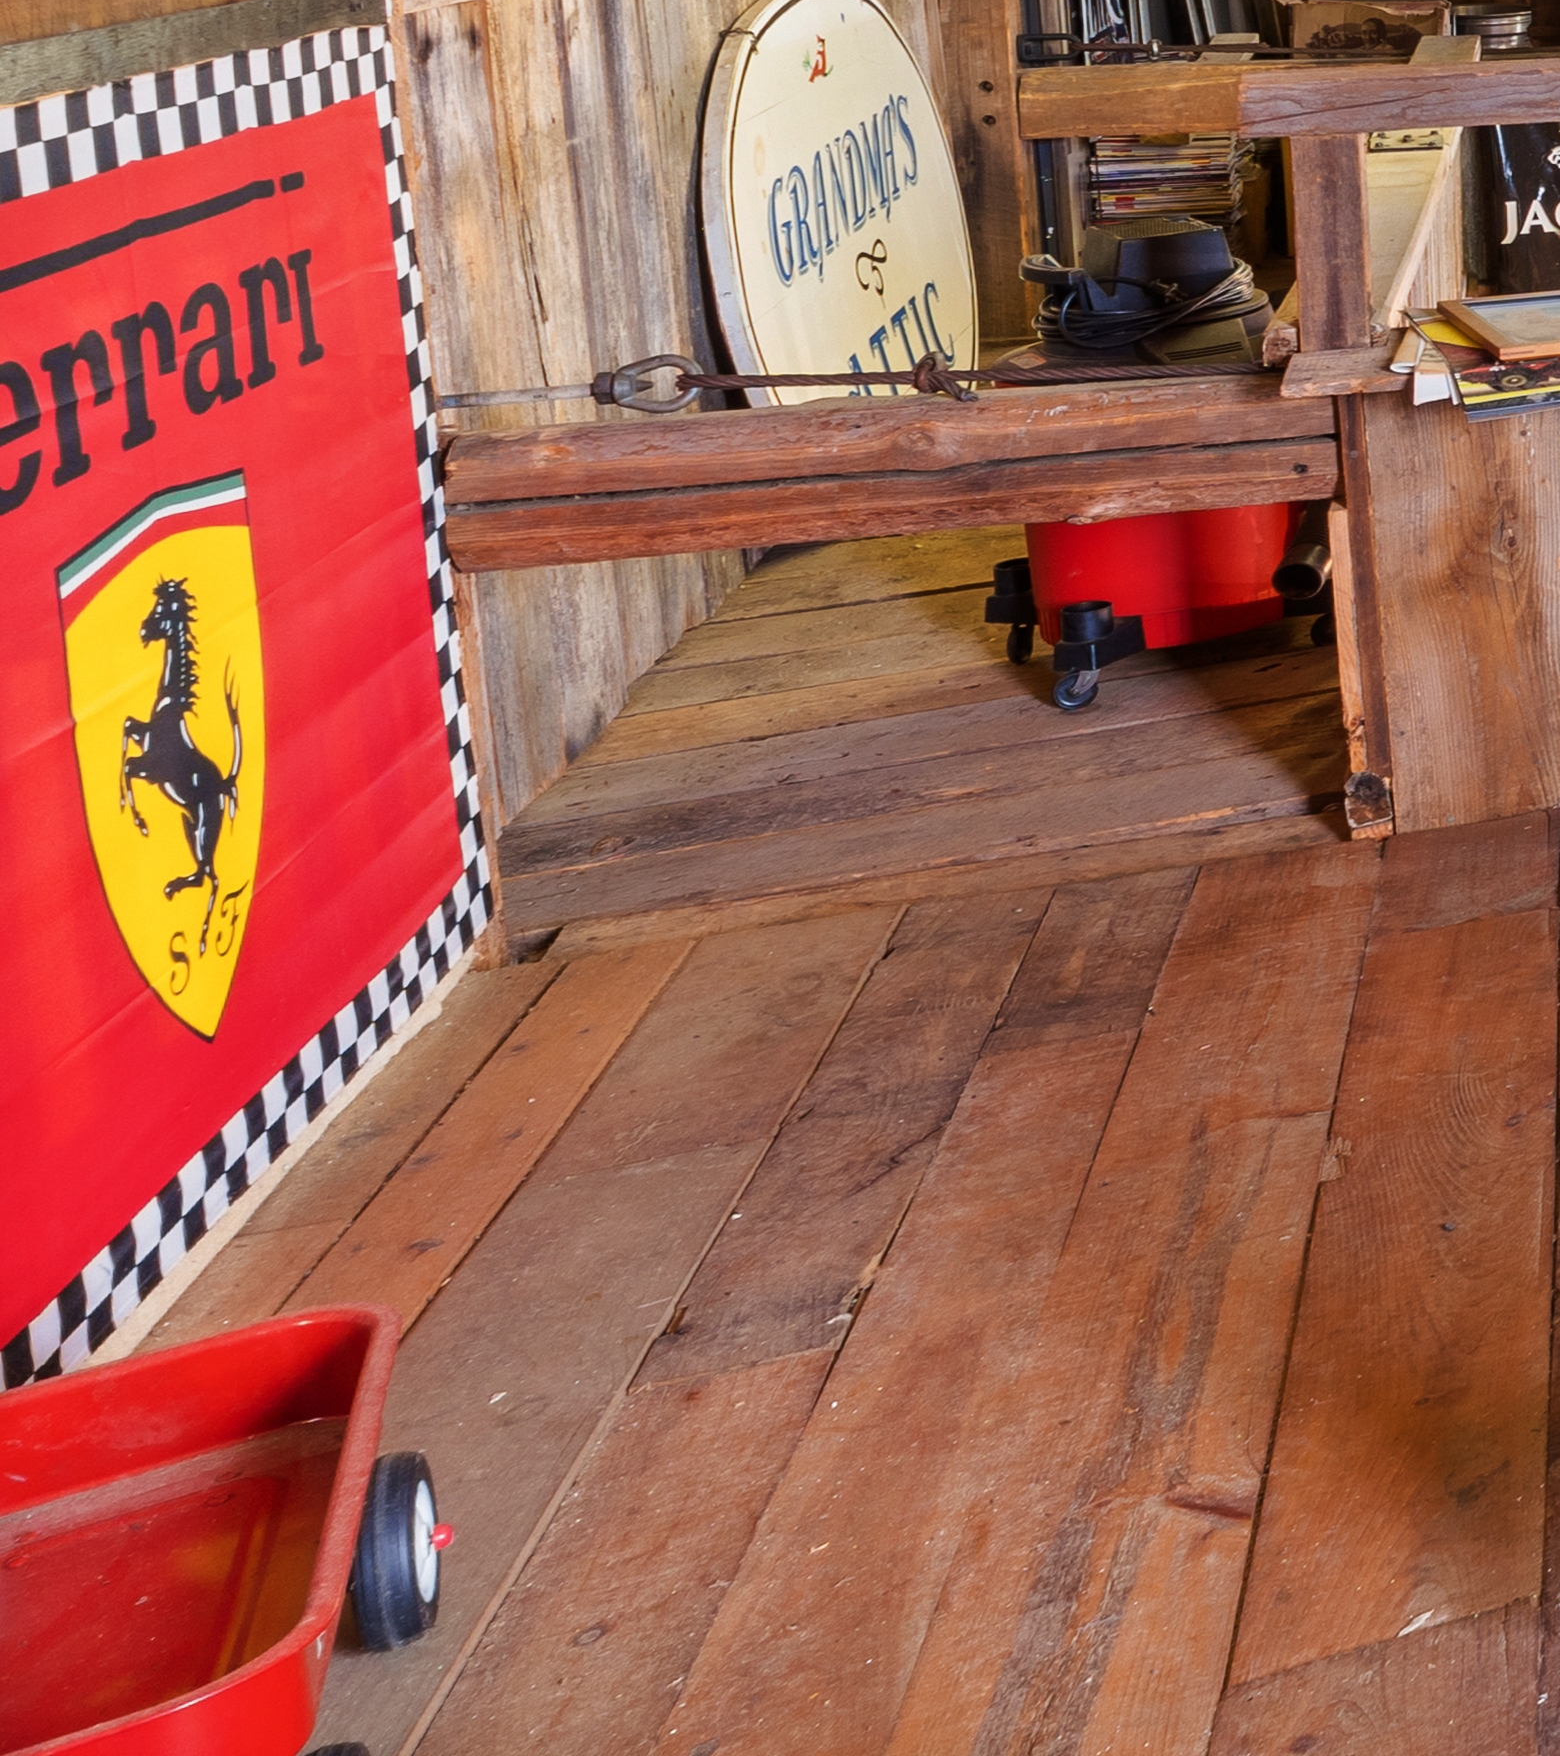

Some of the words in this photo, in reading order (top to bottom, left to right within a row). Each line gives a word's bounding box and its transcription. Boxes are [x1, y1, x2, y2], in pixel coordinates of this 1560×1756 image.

[767, 93, 918, 287] GRANDMA'S
[0, 171, 324, 515] errari
[168, 929, 191, 996] S
[214, 880, 250, 958] F
